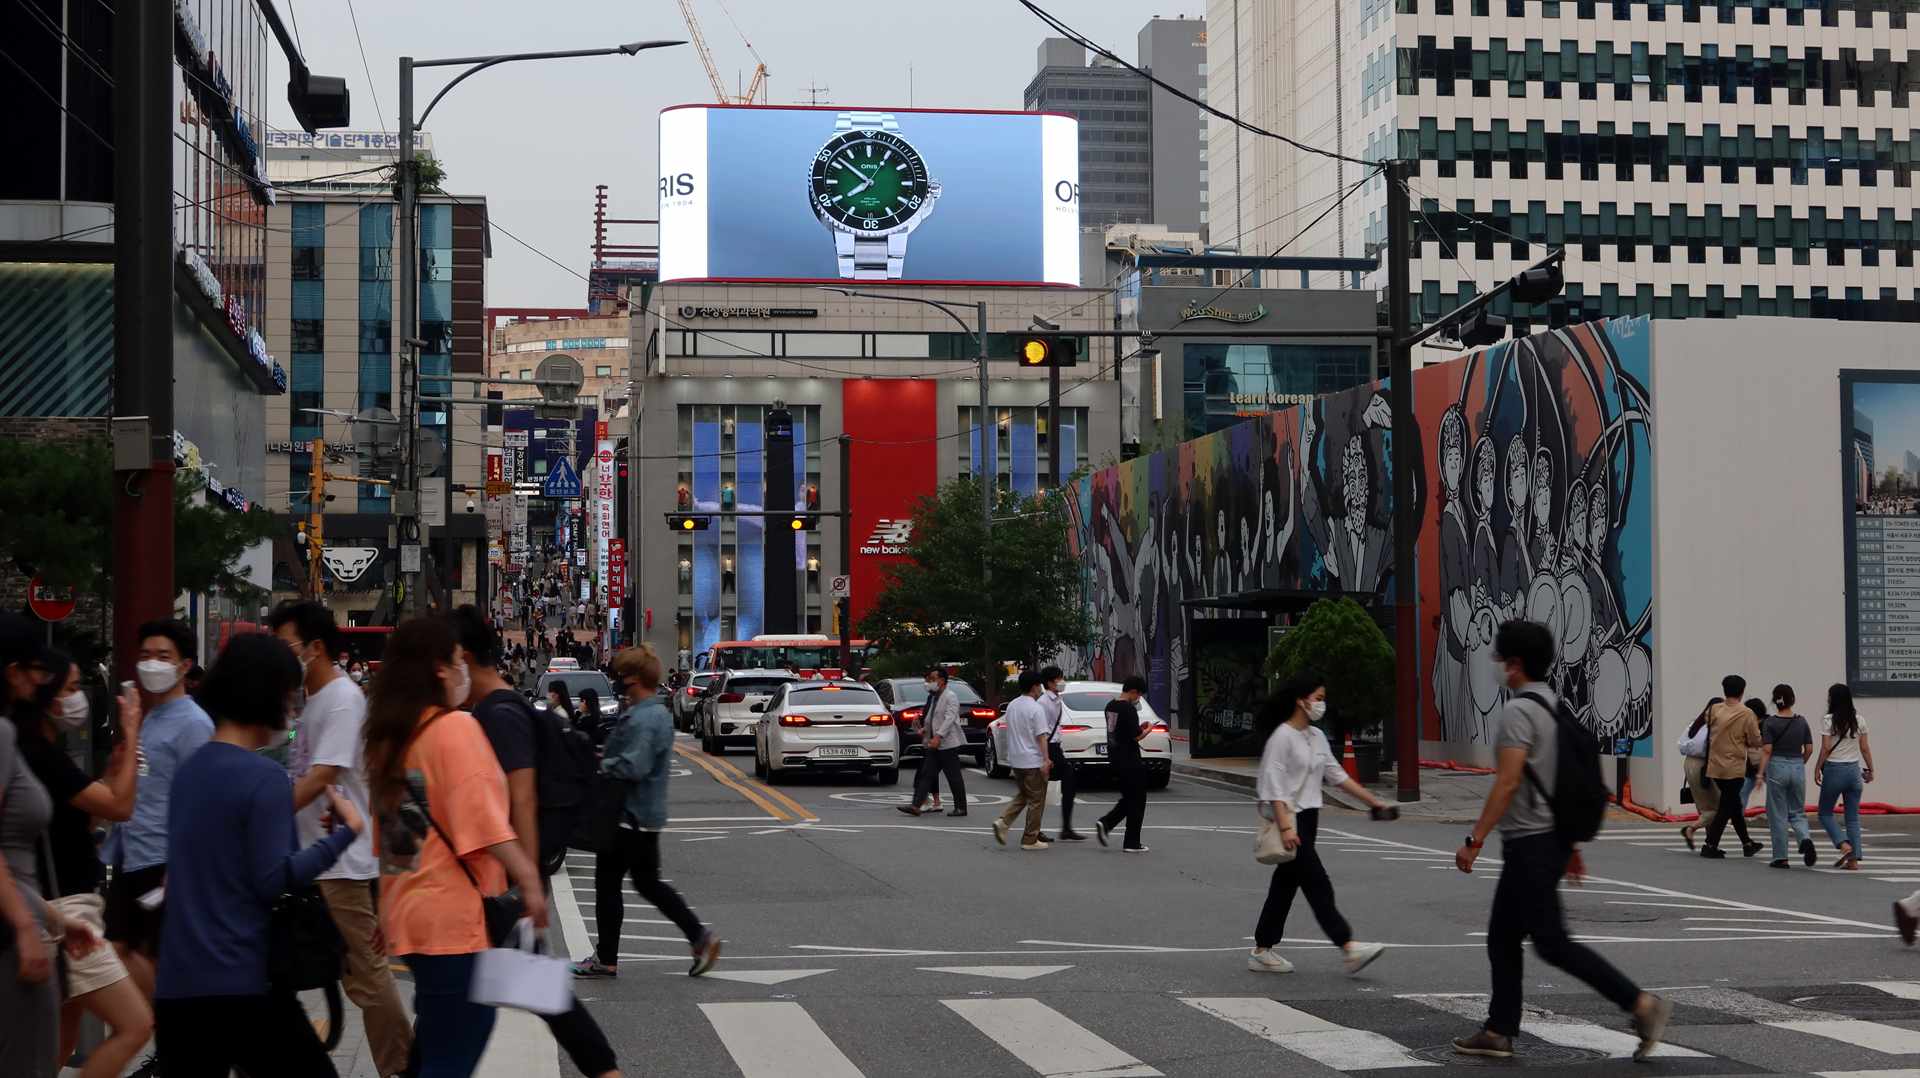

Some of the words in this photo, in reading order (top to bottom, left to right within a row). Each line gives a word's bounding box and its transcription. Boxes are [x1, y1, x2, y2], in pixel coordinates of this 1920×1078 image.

[266, 132, 423, 147] 한국과학기술단체총연회
[818, 148, 832, 162] 50
[818, 194, 832, 208] 40
[908, 194, 921, 209] 20
[863, 220, 879, 229] 30
[1230, 392, 1265, 404] Learn
[1268, 393, 1313, 404] Korean
